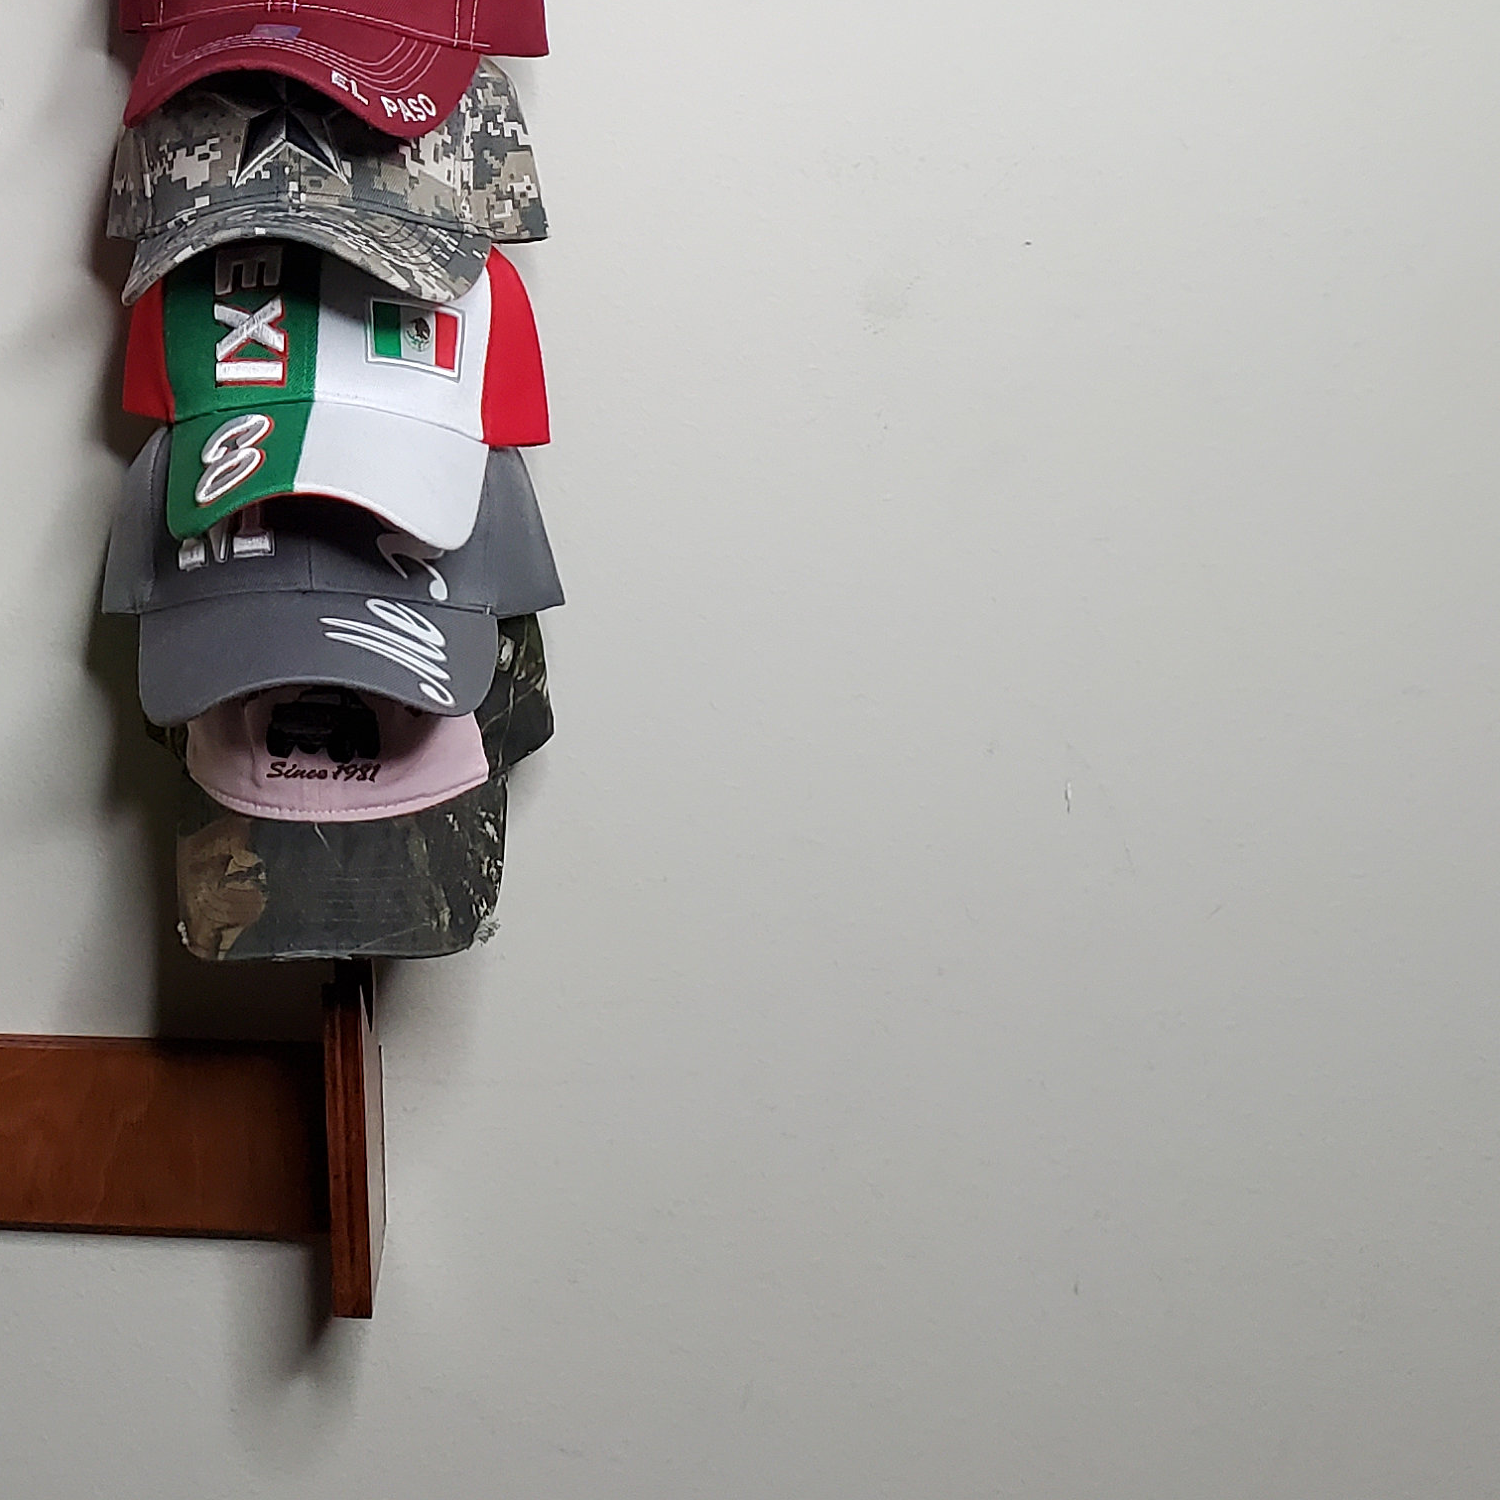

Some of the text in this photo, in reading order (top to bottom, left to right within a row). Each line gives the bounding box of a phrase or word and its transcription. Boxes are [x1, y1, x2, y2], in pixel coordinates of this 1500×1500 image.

[330, 69, 438, 124] EL PASO
[266, 760, 382, 783] Since 1981
